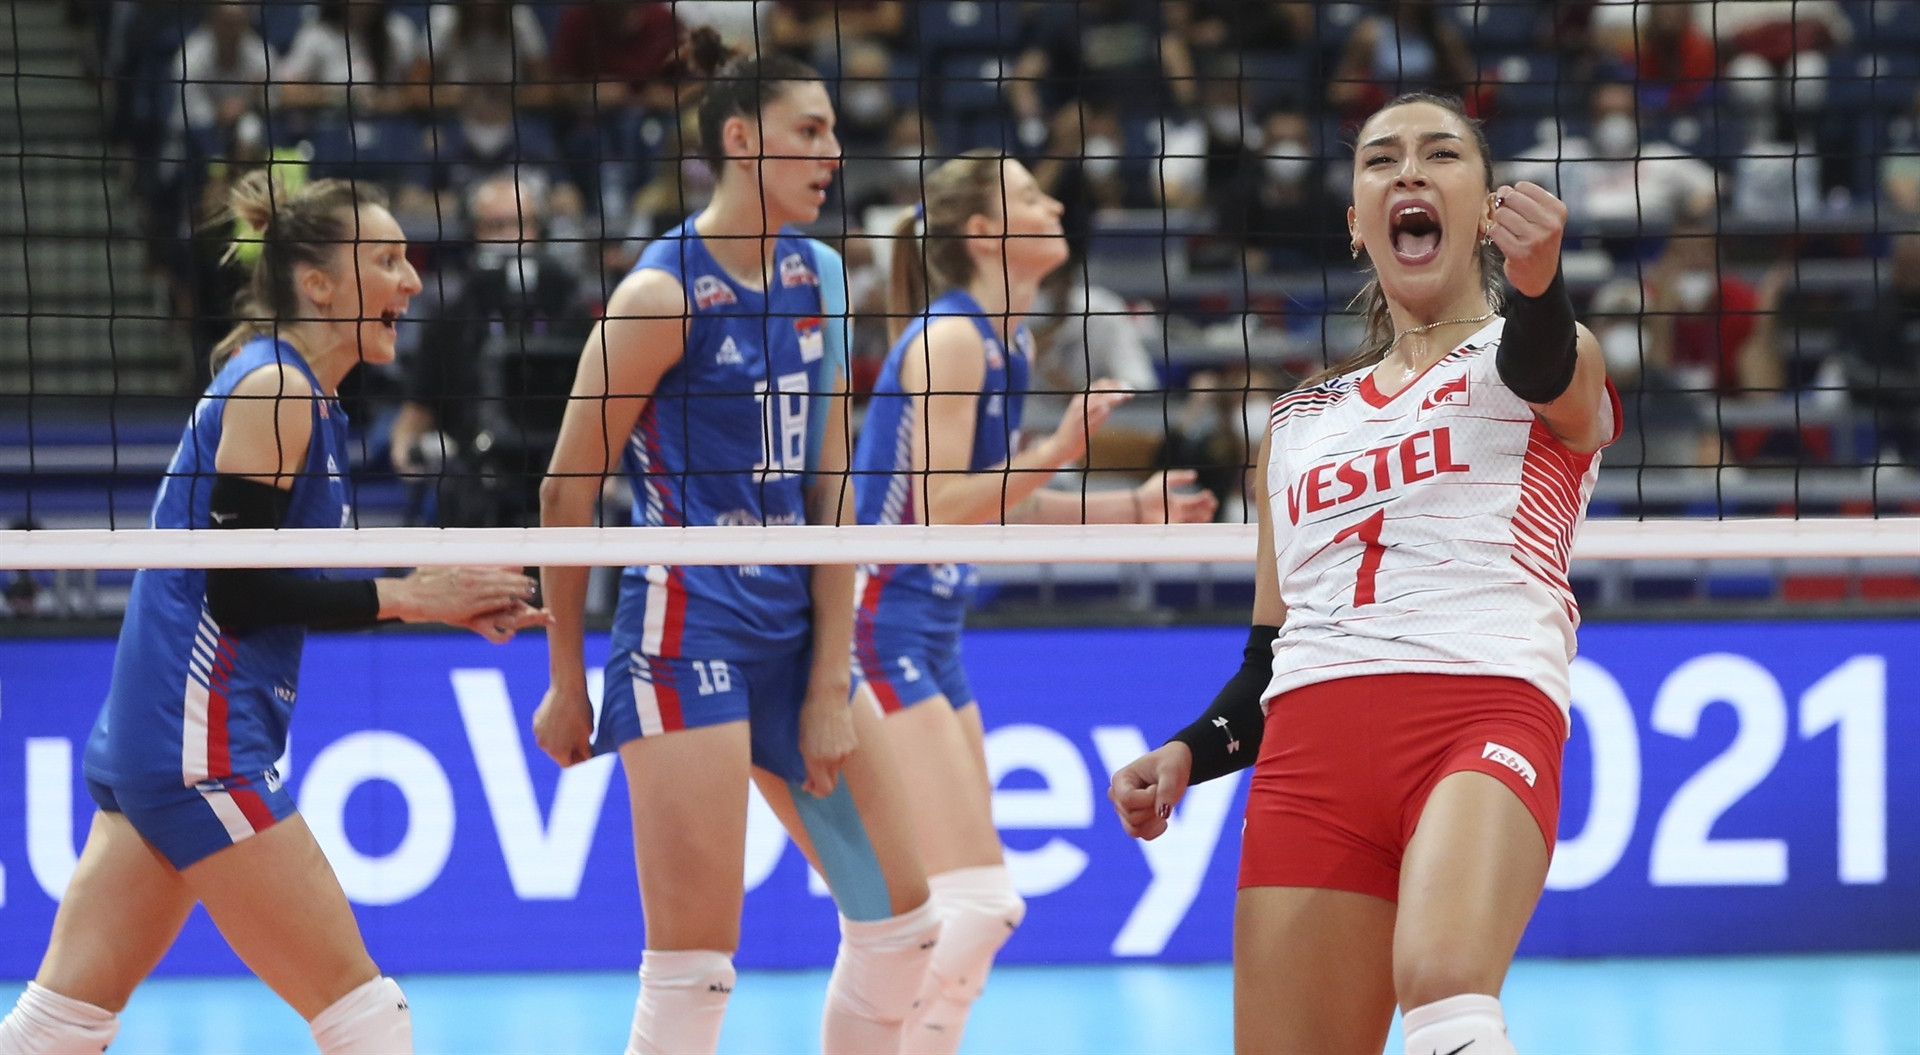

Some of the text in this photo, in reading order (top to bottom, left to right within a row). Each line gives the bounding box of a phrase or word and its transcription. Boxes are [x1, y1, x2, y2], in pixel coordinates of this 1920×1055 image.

[753, 371, 809, 483] 18
[1287, 426, 1470, 527] VESTEL
[1543, 652, 1888, 892] 021
